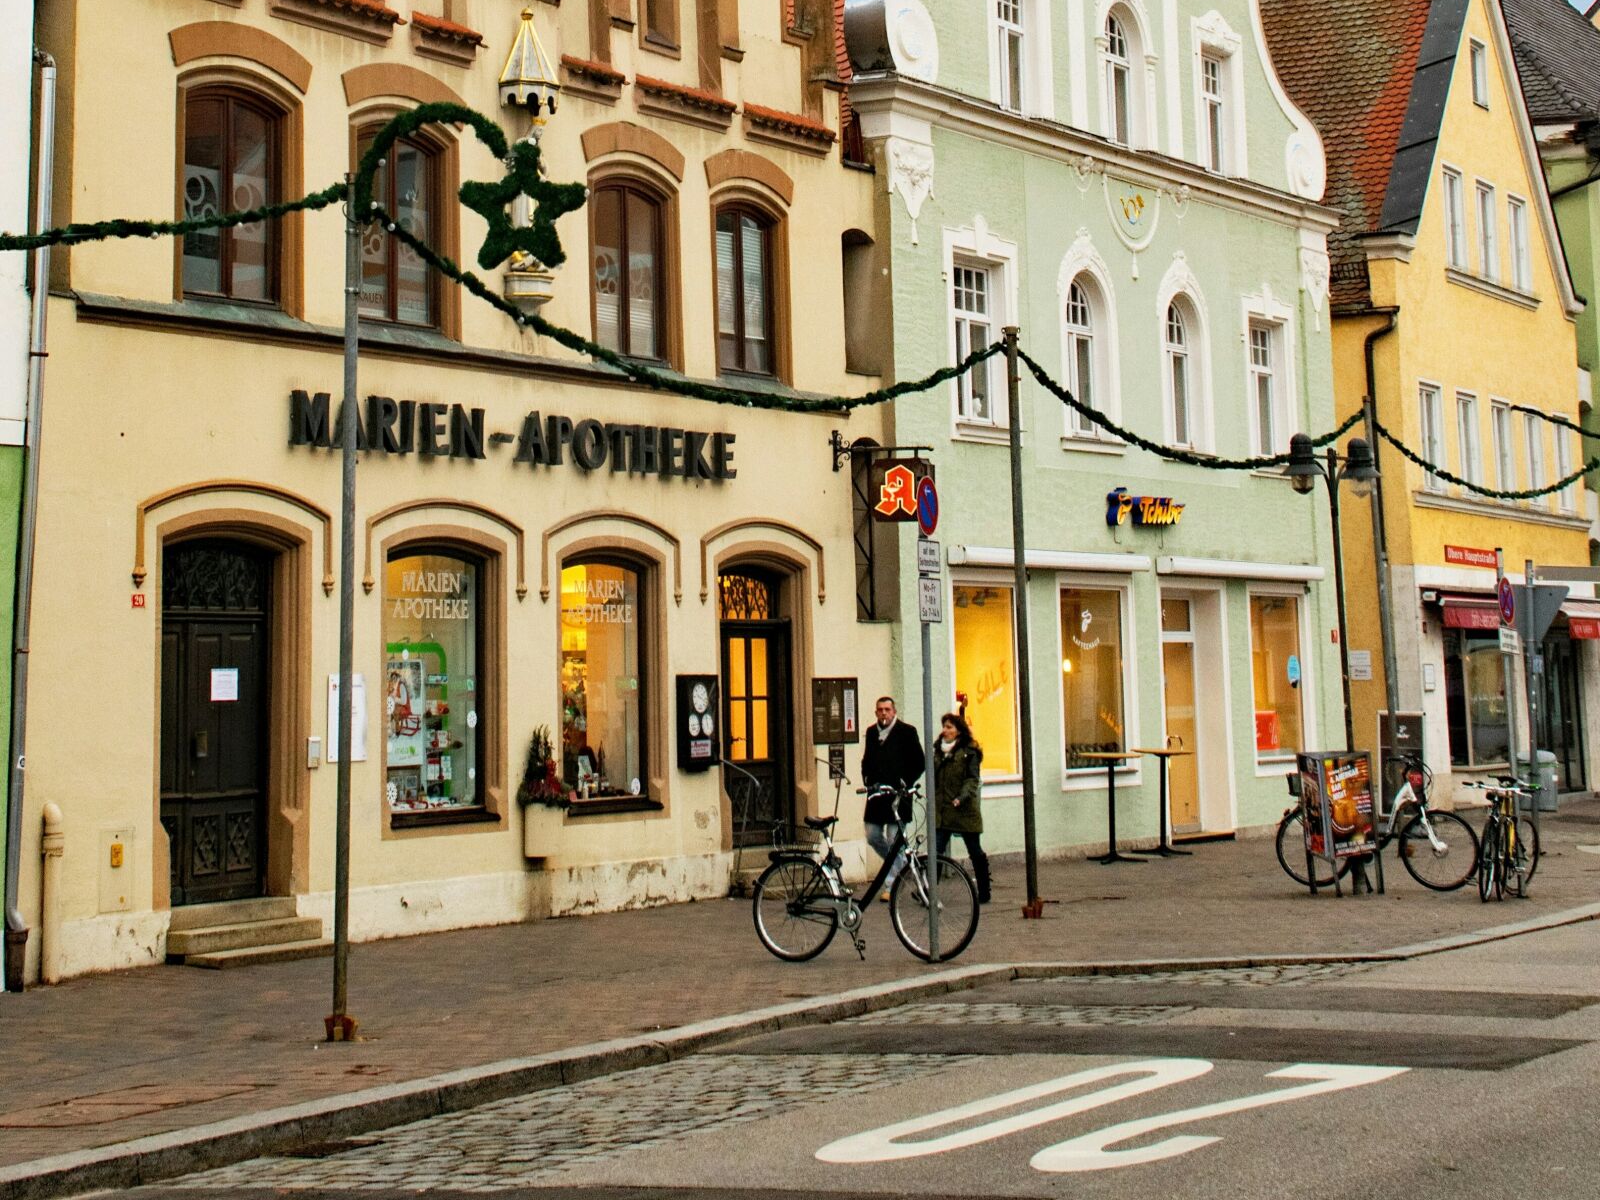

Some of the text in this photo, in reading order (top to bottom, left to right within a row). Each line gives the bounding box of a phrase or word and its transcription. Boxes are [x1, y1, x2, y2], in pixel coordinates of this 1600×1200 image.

[1137, 496, 1185, 525] Tchibo
[1447, 547, 1496, 565] Obere Hauptstraße
[402, 570, 461, 593] MARIEN
[574, 579, 625, 599] MARIEN
[134, 596, 143, 606] 20
[393, 598, 470, 620] APOTHEKE
[567, 603, 633, 624] APOTHEKE
[976, 659, 1009, 704] SALE
